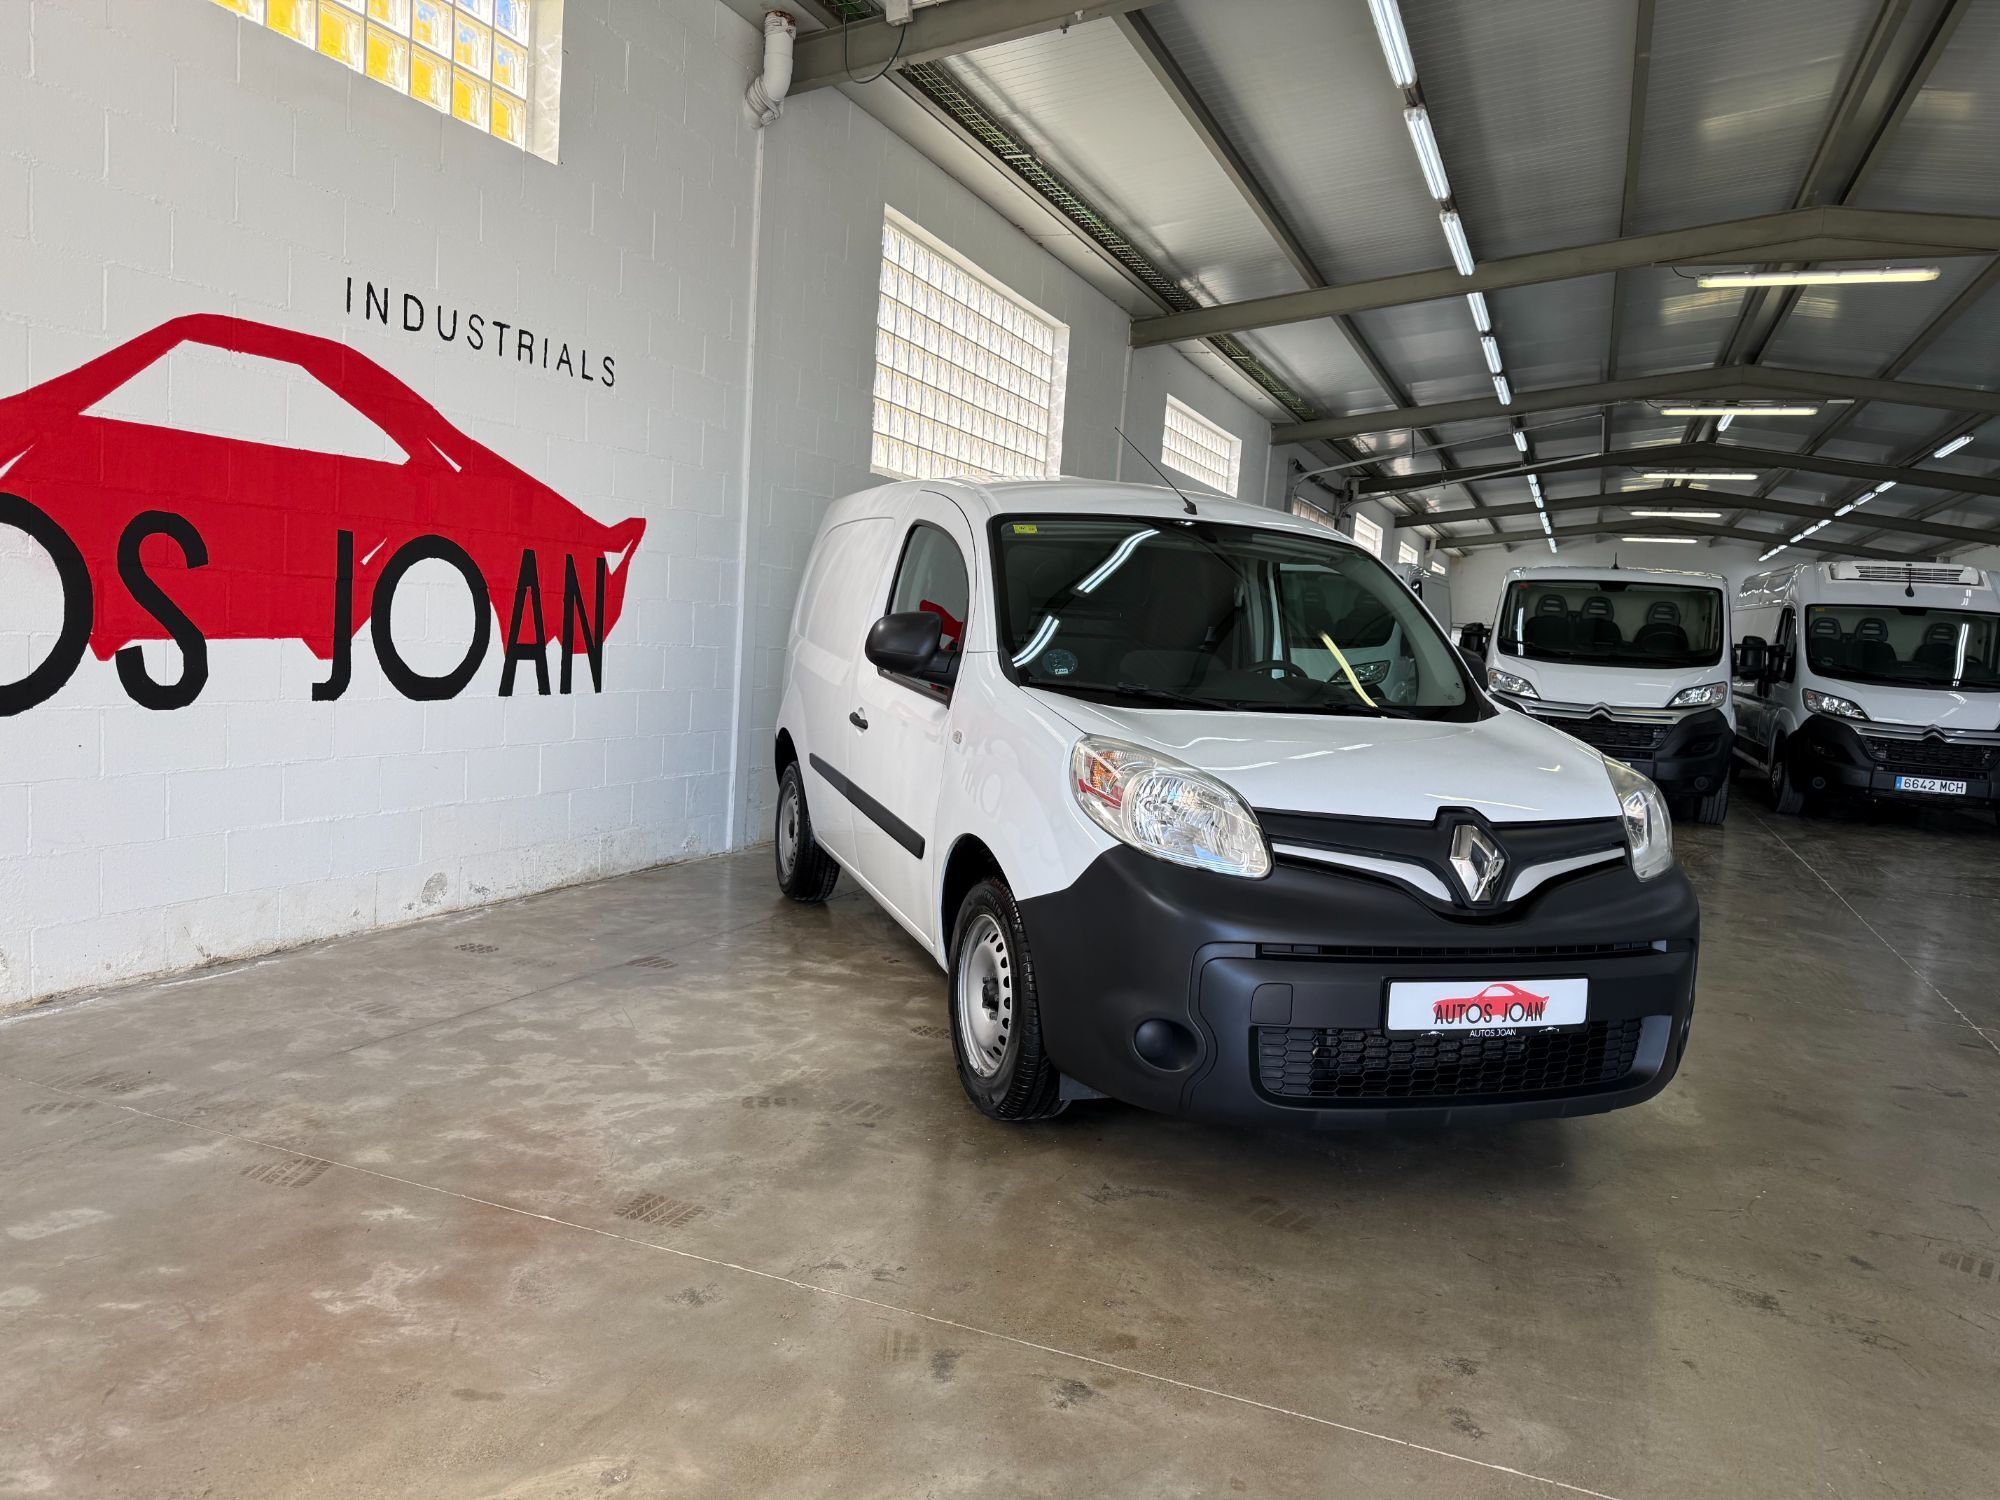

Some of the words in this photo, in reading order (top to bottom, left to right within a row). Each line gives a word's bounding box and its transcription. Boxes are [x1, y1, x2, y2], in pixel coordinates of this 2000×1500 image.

[346, 276, 616, 388] INDUSTRIALS
[311, 529, 606, 701] JOAN
[1904, 778, 1936, 791] 6642
[1939, 781, 1964, 793] MCH
[1434, 1003, 1493, 1025] AUTOS
[1501, 1001, 1544, 1023] JOAN
[1469, 1029, 1495, 1038] AUTOS
[1495, 1028, 1517, 1037] JOAN
